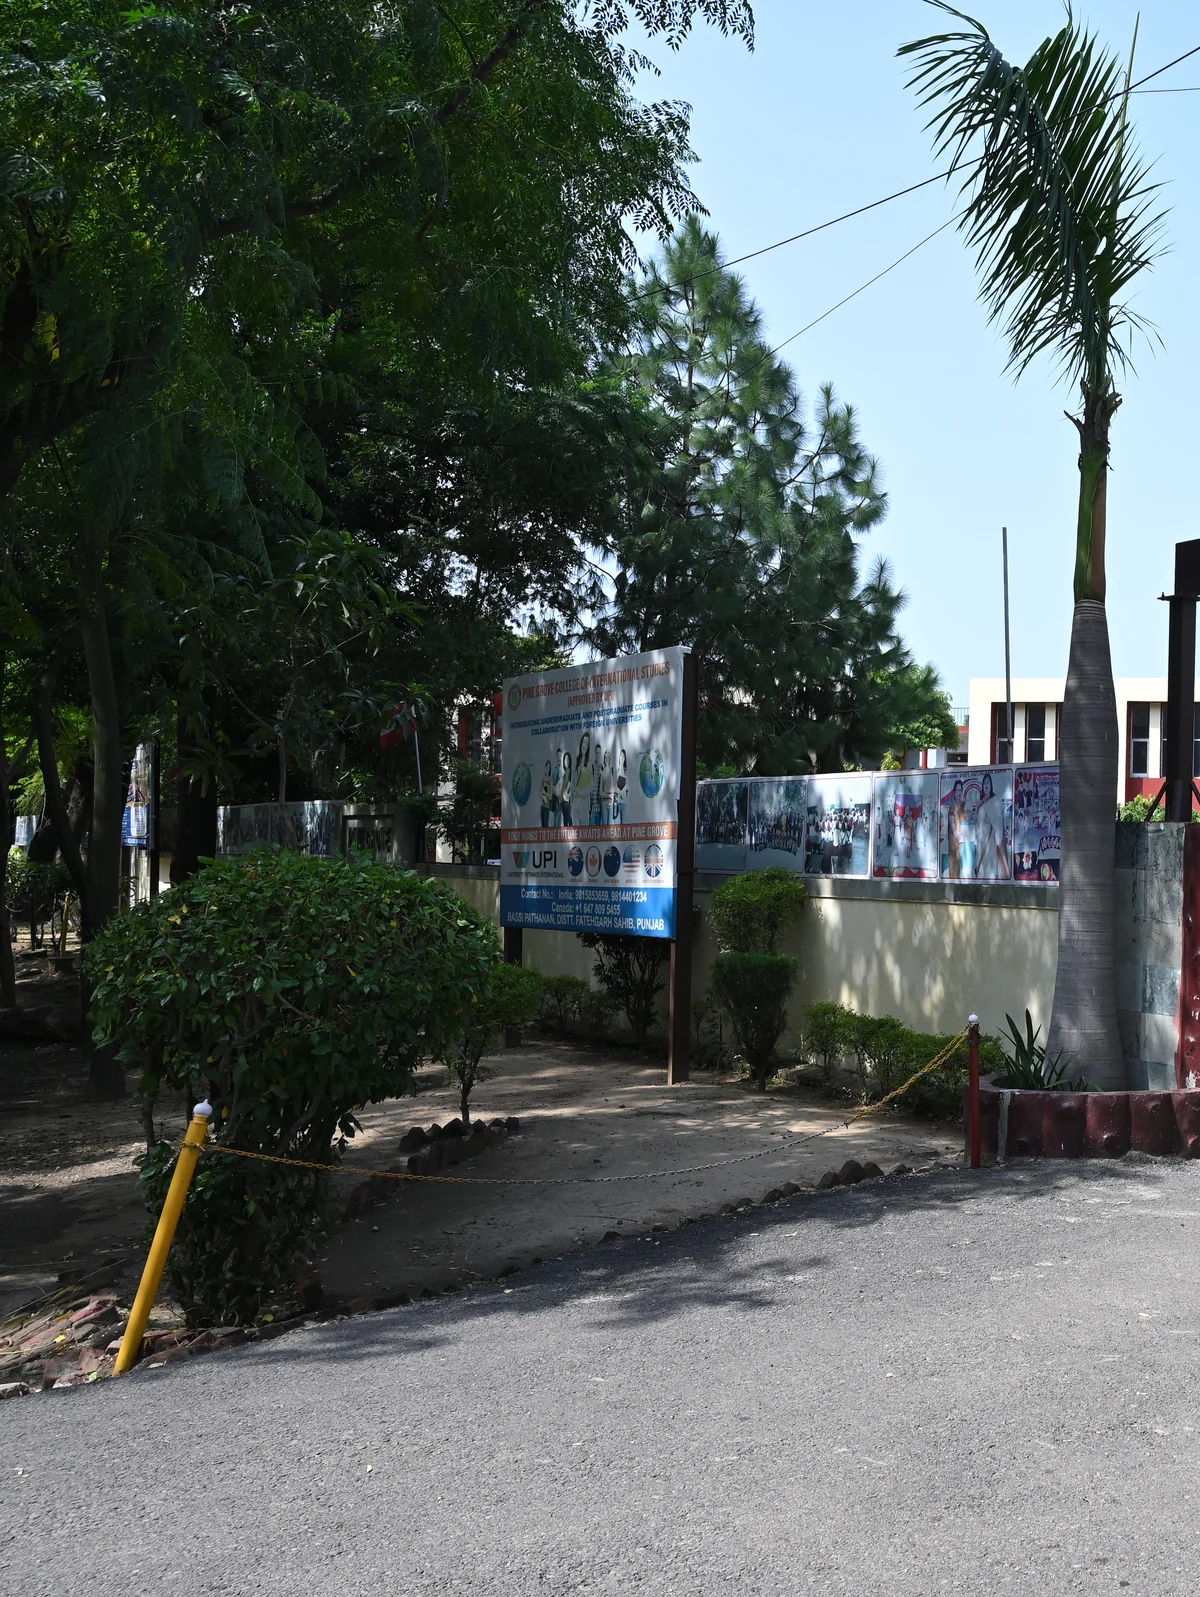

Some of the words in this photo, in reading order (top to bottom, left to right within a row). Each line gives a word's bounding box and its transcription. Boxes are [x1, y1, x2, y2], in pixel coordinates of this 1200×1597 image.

[522, 686, 535, 700] PINE
[536, 682, 554, 697] GROVE
[555, 678, 580, 694] COLLEGE
[581, 676, 588, 689] OF
[590, 667, 639, 688] INTERNATIONAL
[641, 661, 670, 679] STUDIES
[510, 719, 540, 729] INTRODUCING
[541, 713, 581, 725] UNDERGRADUATE
[582, 711, 592, 719] AND
[594, 705, 634, 718] POSTGRADUATE
[635, 701, 661, 711] COURSES
[662, 699, 668, 707] IN
[531, 724, 569, 735] COLLABORATION
[570, 722, 582, 731] WITH
[583, 720, 605, 729] FOREIGN
[606, 714, 642, 726] UNIVERSITIES
[508, 831, 521, 841] YOUR
[521, 831, 538, 841] WINGS
[539, 831, 545, 840] TO
[547, 830, 556, 840] THE
[557, 829, 578, 840] FUTURE
[579, 828, 601, 839] AWAITS
[602, 827, 622, 839] AHEAD
[623, 827, 631, 838] AT
[632, 827, 646, 837] PINE
[647, 825, 668, 837] GROVE
[532, 851, 557, 868] UPI
[521, 888, 541, 899] Contact
[559, 889, 574, 899] India:
[611, 891, 647, 902] 9814401234
[552, 902, 574, 913] Canada:
[575, 903, 582, 913] +1
[583, 903, 593, 913] 647
[606, 904, 620, 915] 5455
[508, 912, 523, 922] BASSI
[524, 913, 556, 926] PATHANAN,
[557, 914, 574, 925] DISTT.
[576, 916, 612, 928] FATEHGARH
[614, 917, 635, 931] SAHIB,
[637, 918, 664, 931] PUNJAB
